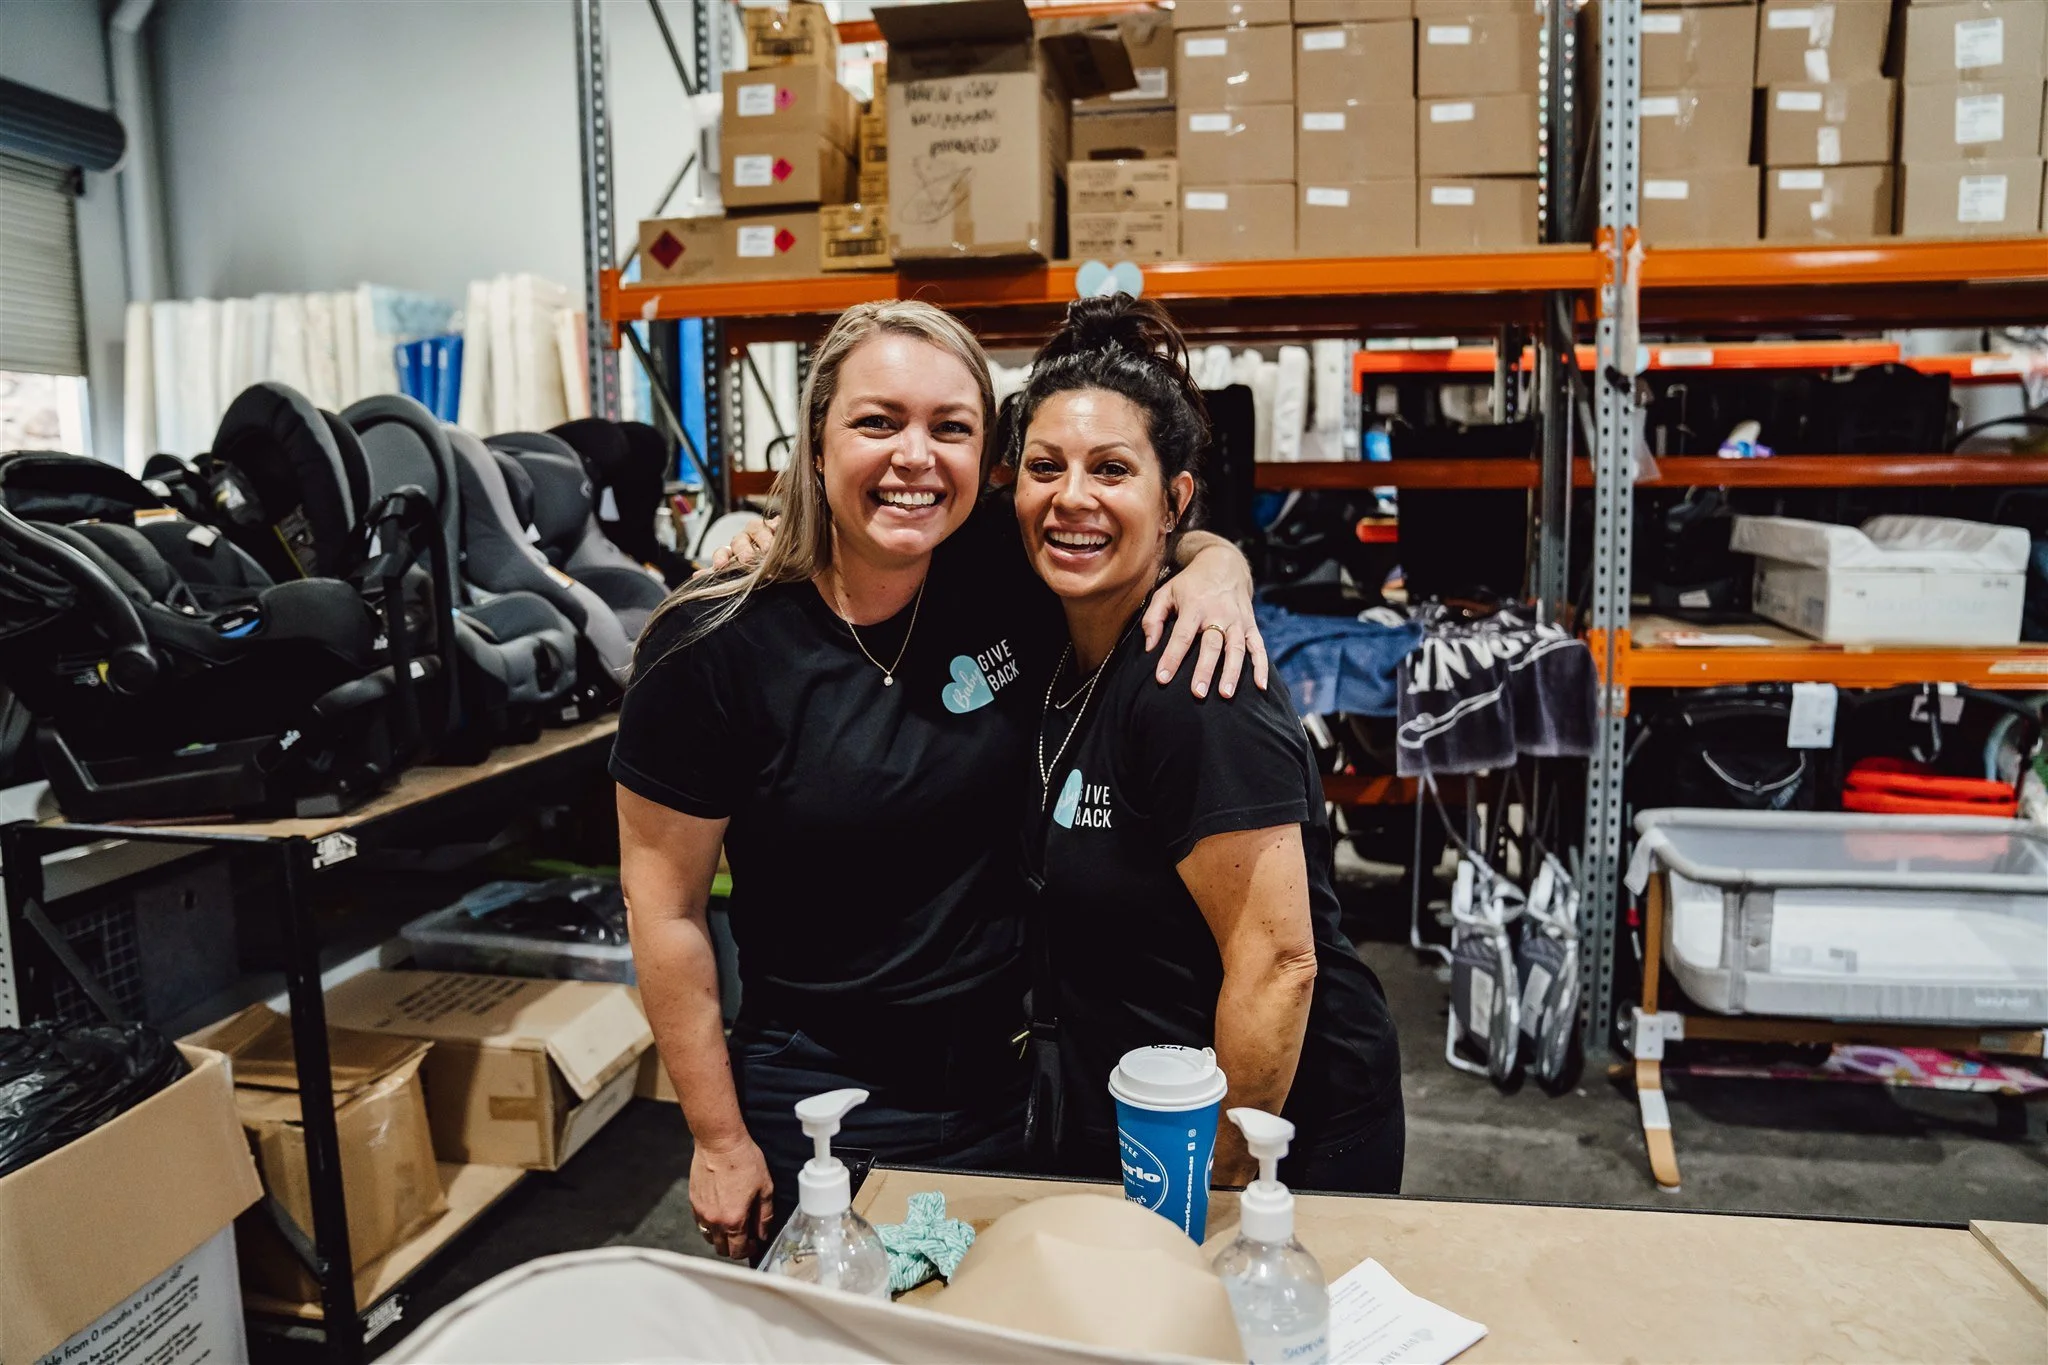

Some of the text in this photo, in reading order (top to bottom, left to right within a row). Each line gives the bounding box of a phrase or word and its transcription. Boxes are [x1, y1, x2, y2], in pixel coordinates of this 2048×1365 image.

[977, 639, 1012, 672] GIVE
[986, 658, 1020, 692] BACK
[1079, 783, 1111, 805] IVE
[1074, 806, 1112, 828] BACK
[1121, 1158, 1161, 1183] erlo
[64, 1339, 89, 1359] from
[91, 1328, 99, 1341] 0
[101, 1307, 133, 1336] months
[133, 1301, 142, 1311] to
